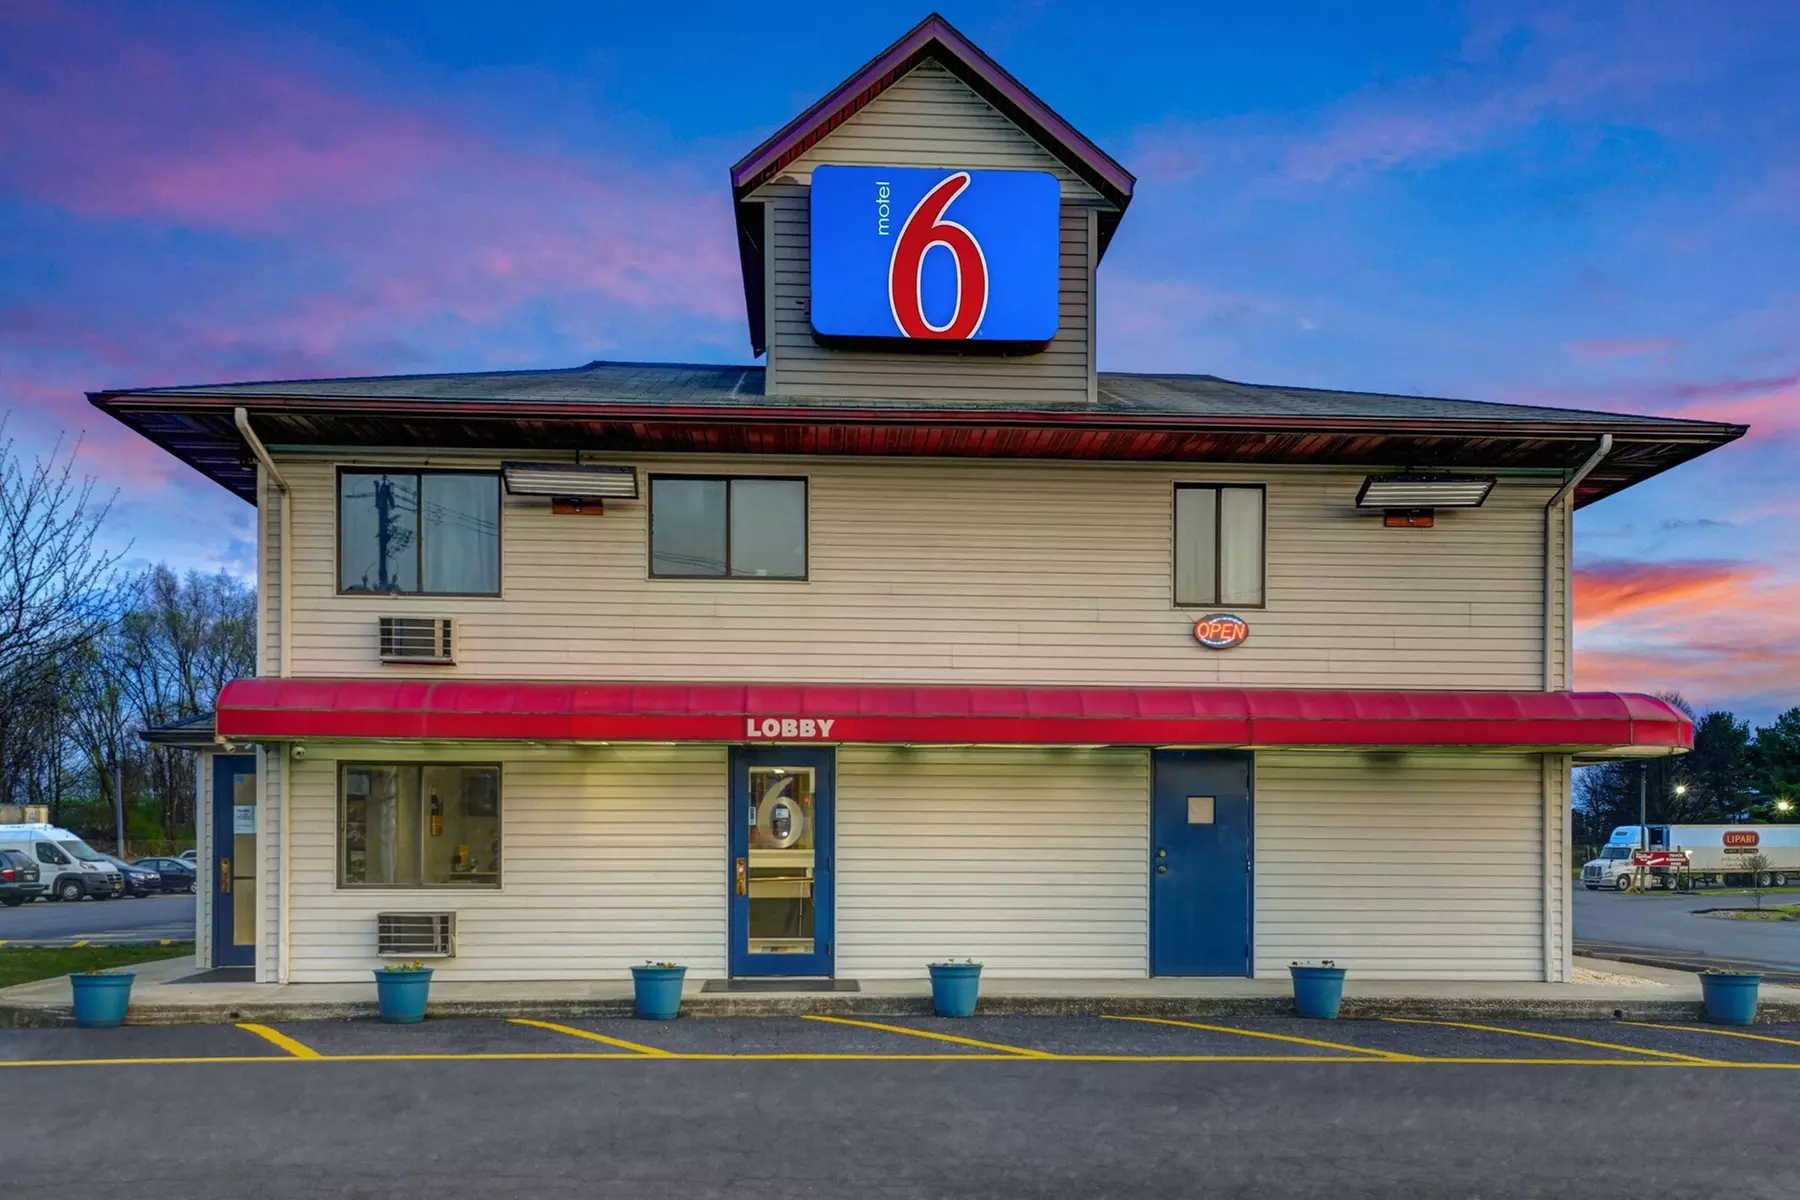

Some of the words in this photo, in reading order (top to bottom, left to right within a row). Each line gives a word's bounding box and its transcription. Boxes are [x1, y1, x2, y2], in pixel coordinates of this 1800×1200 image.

[876, 181, 890, 236] motel
[888, 171, 989, 340] 6
[1196, 622, 1246, 640] OPEN
[747, 718, 835, 738] LOBBY
[757, 777, 804, 849] 6
[1727, 835, 1756, 844] LIPARI
